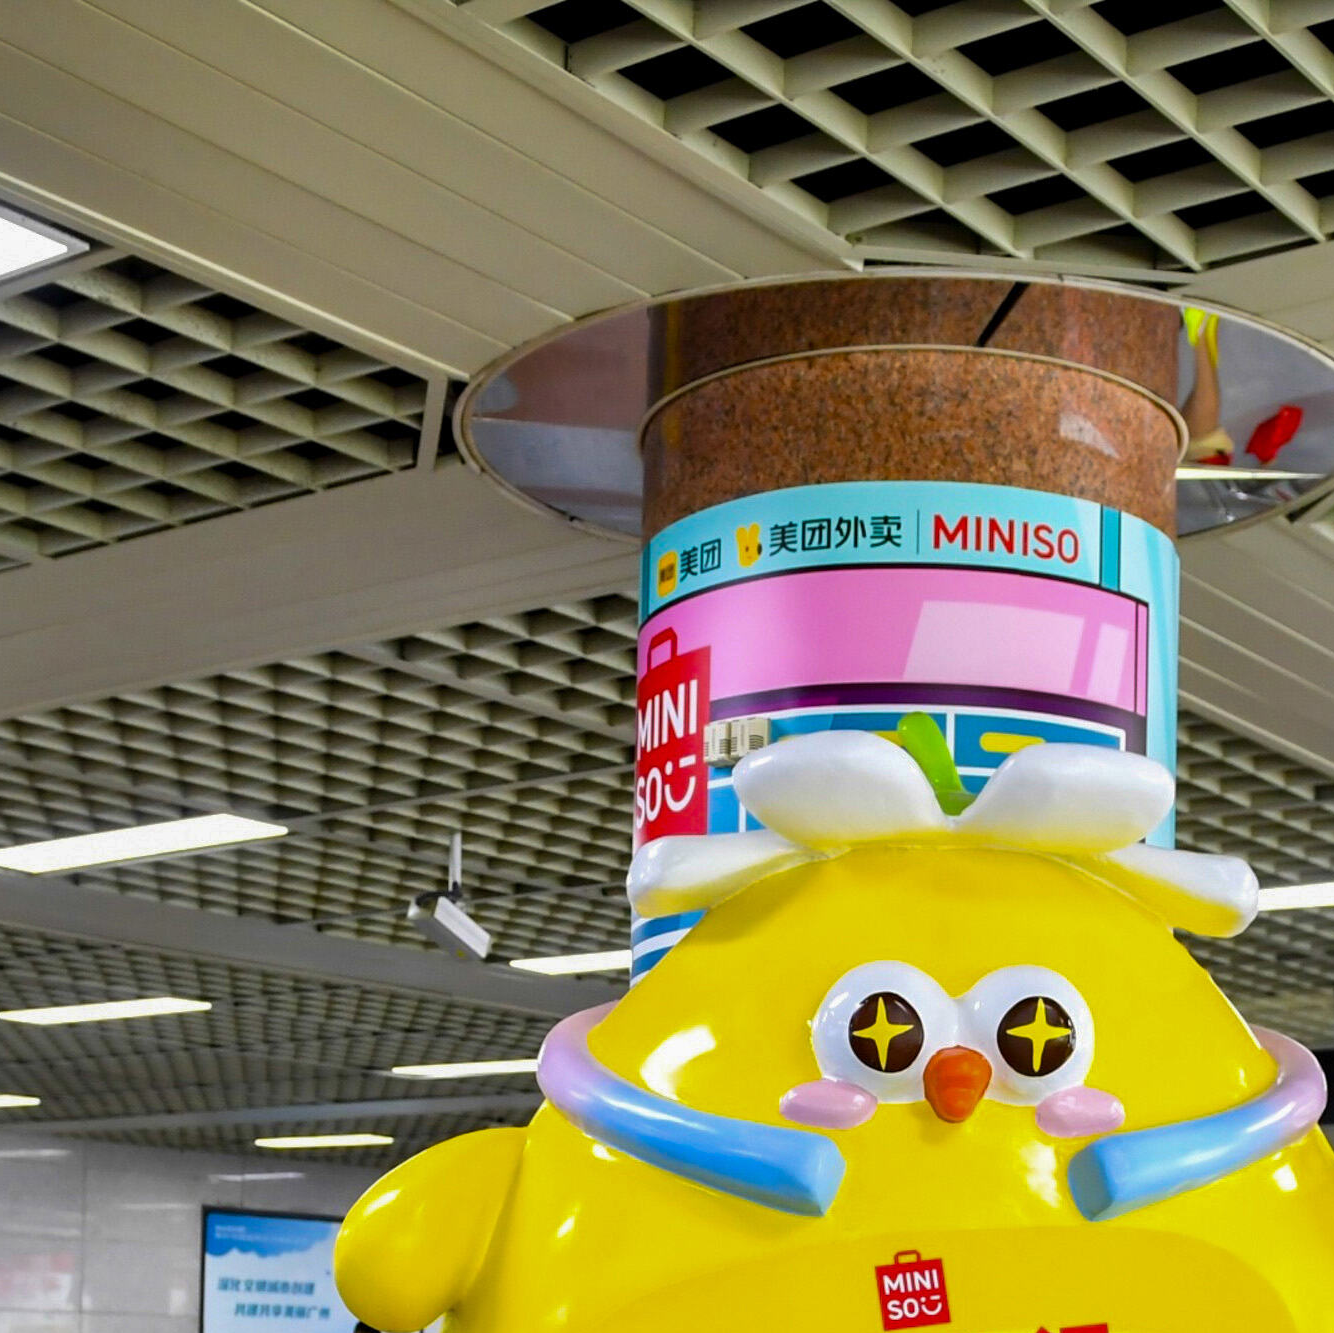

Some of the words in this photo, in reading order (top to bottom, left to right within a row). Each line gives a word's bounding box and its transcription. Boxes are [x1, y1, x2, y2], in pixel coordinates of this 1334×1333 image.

[679, 537, 722, 584] 美团
[768, 515, 903, 557] 美团外卖
[932, 513, 1080, 564] MINISO
[636, 678, 698, 754] MINI
[882, 1268, 941, 1295] MINI
